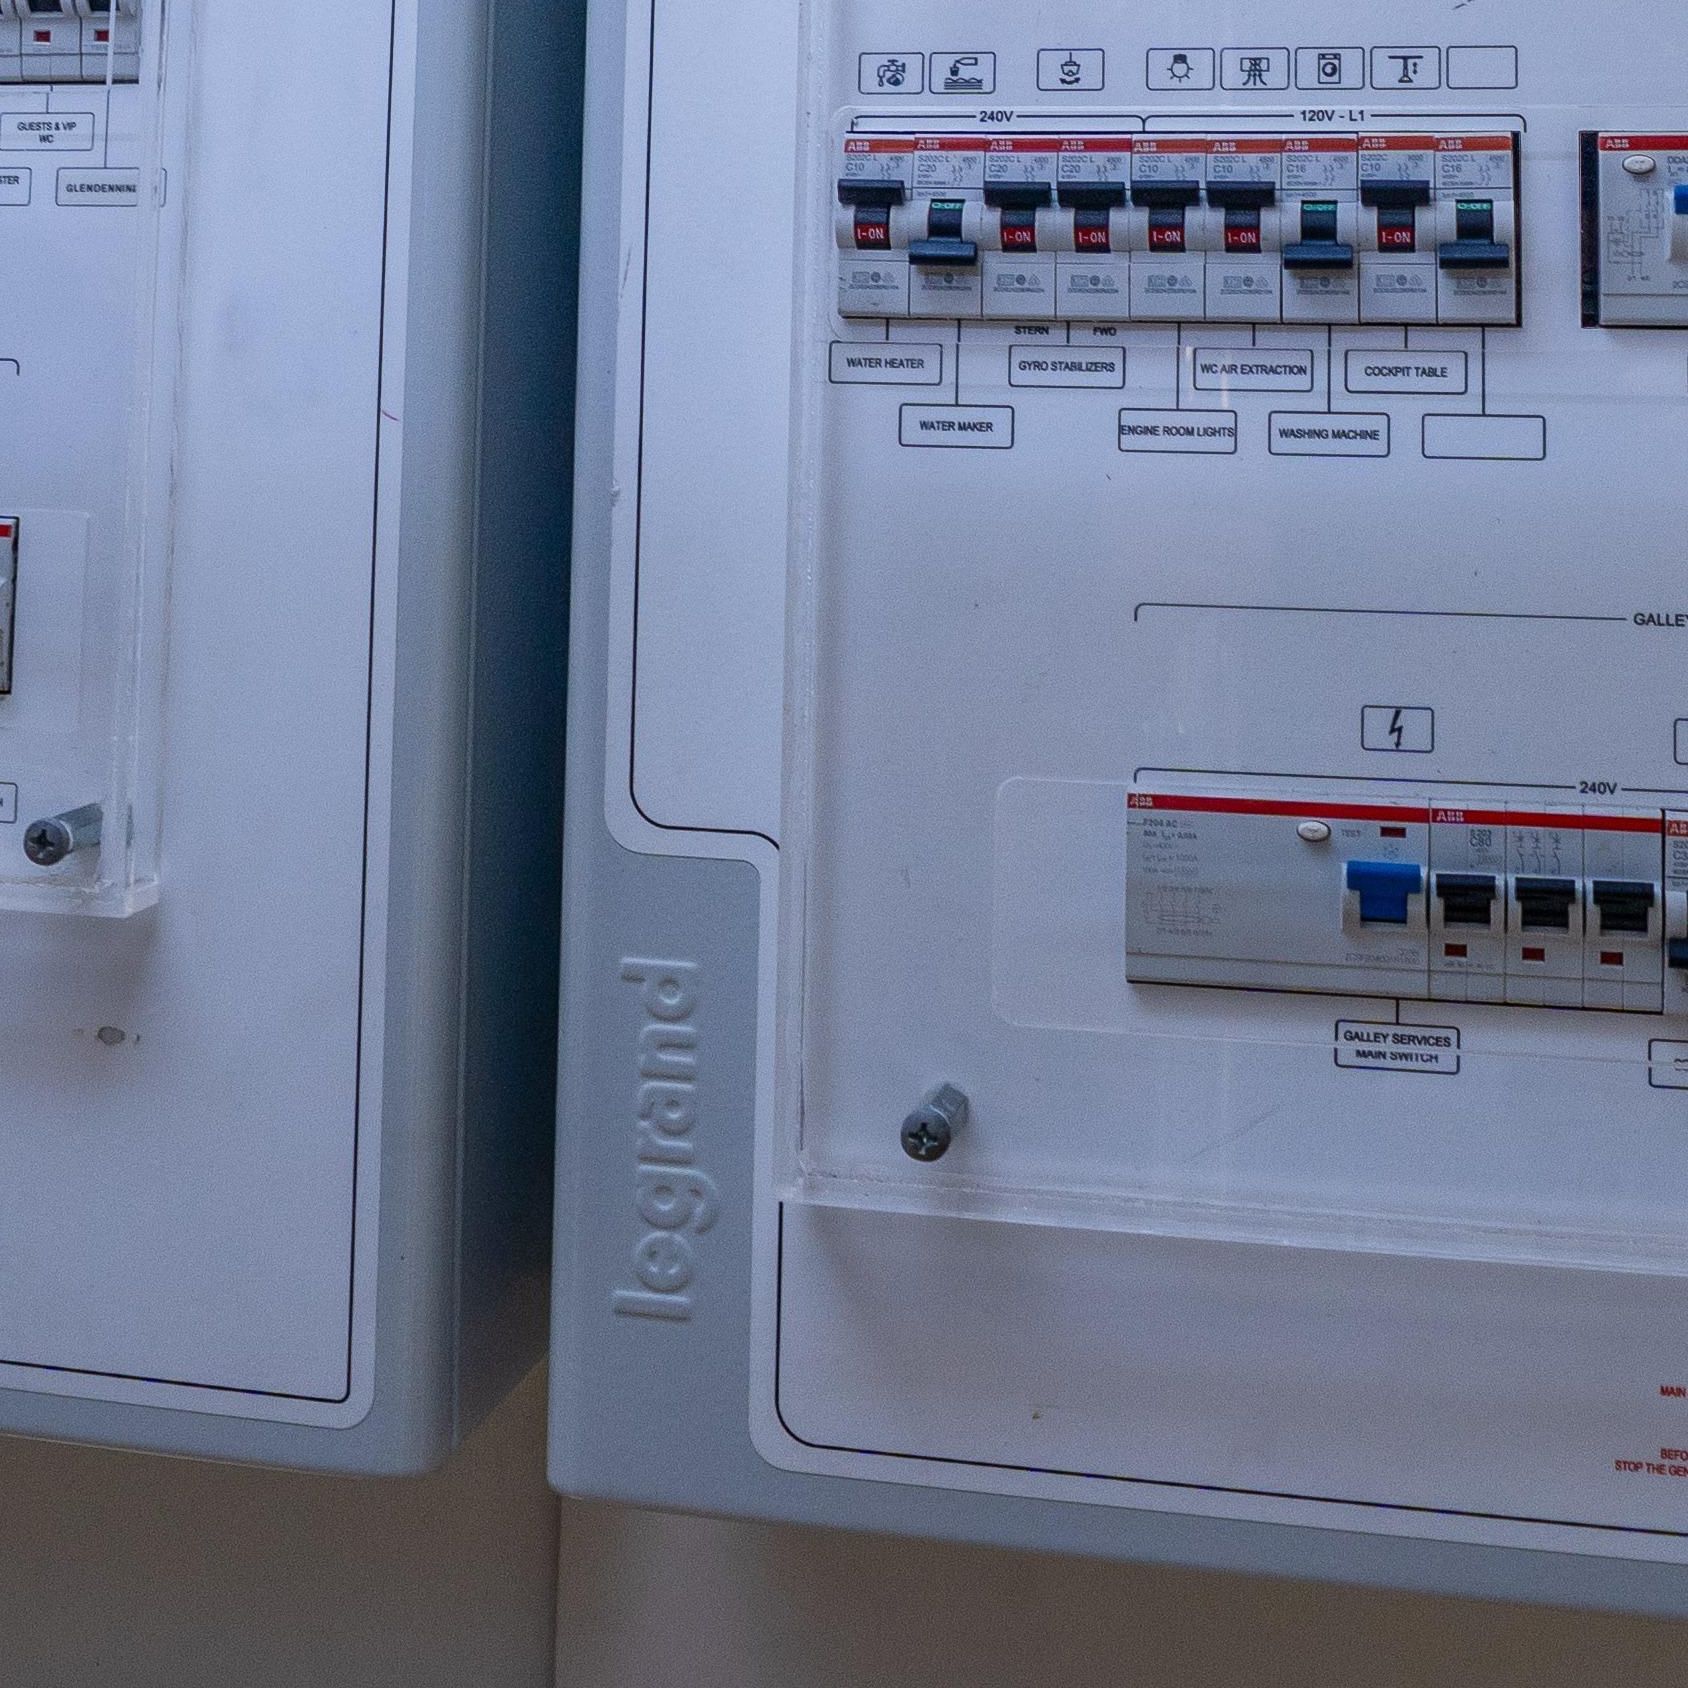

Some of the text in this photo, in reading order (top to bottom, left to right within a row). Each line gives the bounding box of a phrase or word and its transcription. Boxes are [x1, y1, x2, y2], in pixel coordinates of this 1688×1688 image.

[1301, 110, 1365, 121] 120V L1
[920, 421, 993, 432] WATER MAKER
[1279, 429, 1379, 440] WASHING MACHINE
[1580, 781, 1617, 795] 240V
[1344, 1030, 1451, 1047] GALLEY SERVICES
[614, 957, 715, 1322] legrand
